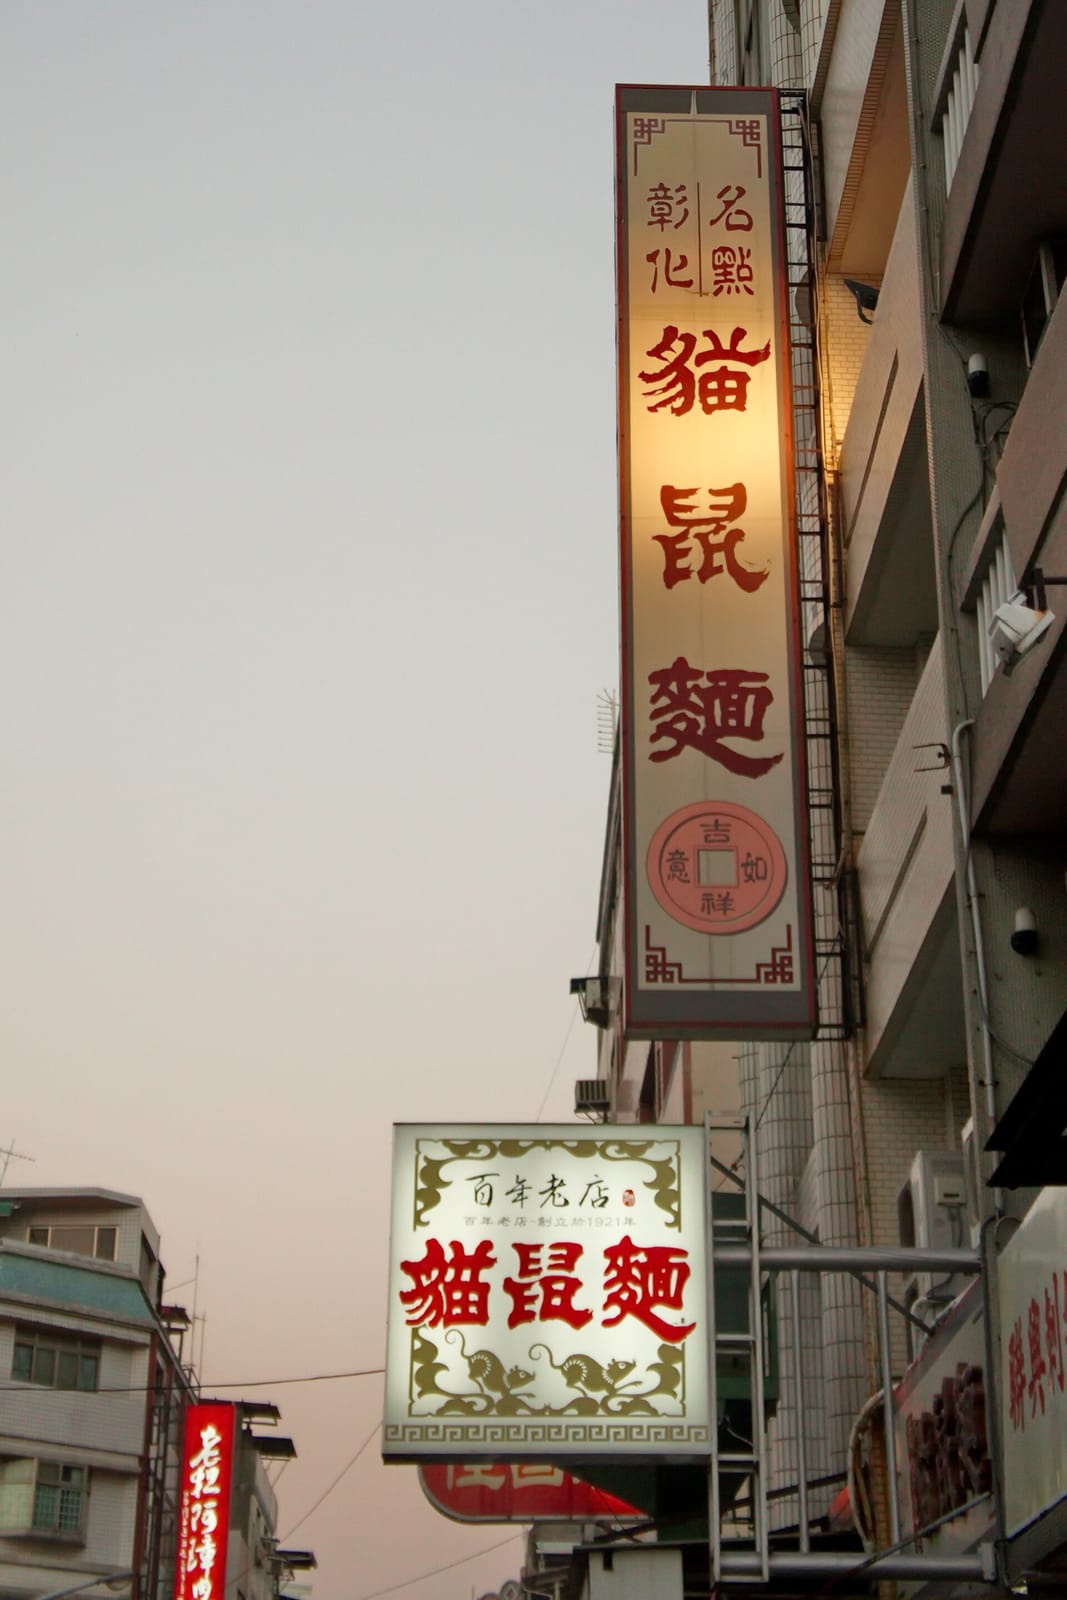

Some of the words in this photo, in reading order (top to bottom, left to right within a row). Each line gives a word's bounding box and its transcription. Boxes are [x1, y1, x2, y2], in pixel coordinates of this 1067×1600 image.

[646, 182, 694, 294] 彰化
[709, 184, 755, 296] 名點
[638, 325, 785, 778] 貓鼠麵
[699, 818, 732, 844] 吉
[464, 1172, 611, 1209] 百年老店
[400, 1235, 696, 1343] 貓鼠麵
